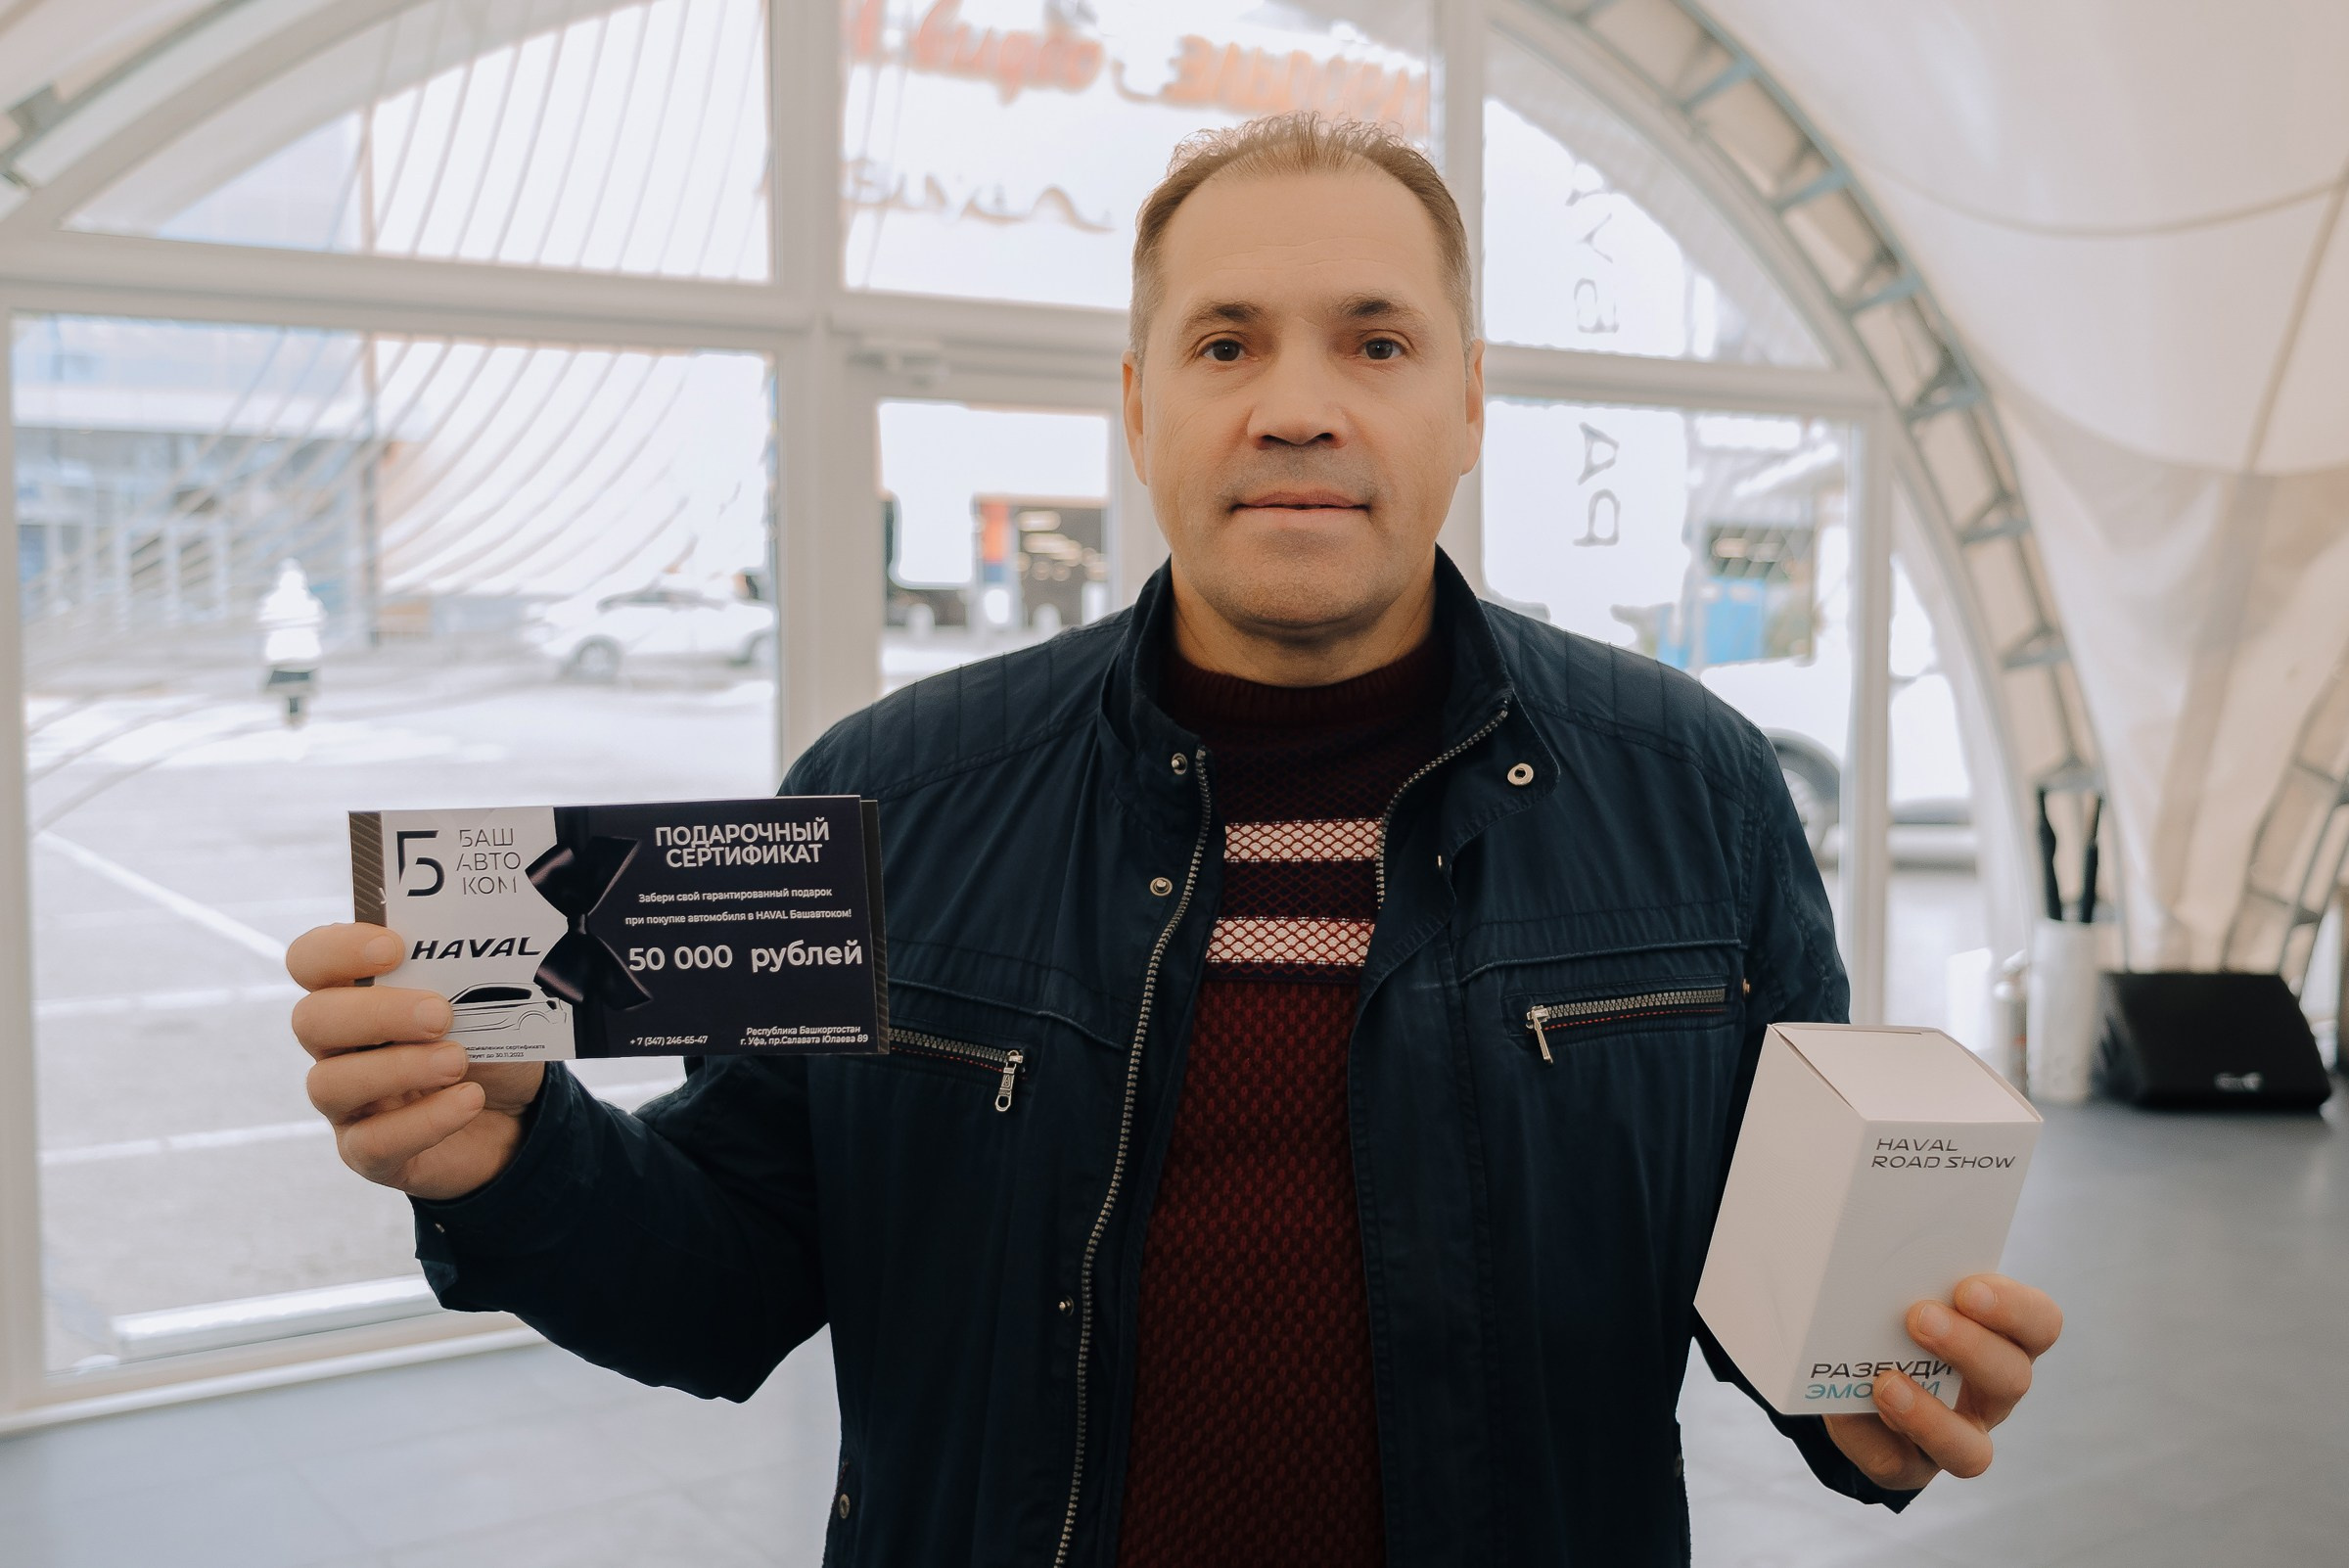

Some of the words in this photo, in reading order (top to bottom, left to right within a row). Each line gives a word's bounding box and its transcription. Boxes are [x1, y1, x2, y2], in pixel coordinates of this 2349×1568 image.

[459, 828, 514, 848] БАШ
[655, 816, 830, 848] ПОДАРОЧНЫЙ
[456, 852, 521, 871] АВТО
[666, 844, 823, 868] СЕРТИФИКАТ
[463, 876, 517, 895] КОМ
[638, 893, 674, 904] Забери
[676, 891, 700, 901] свой
[702, 888, 789, 902] гарантированный
[791, 889, 832, 899] подарок
[624, 917, 644, 927] при
[646, 915, 686, 926] покупке
[687, 911, 746, 922] автомобиля
[756, 910, 788, 920] HAVAL
[789, 908, 852, 919] Башавтоком!
[410, 936, 541, 960] HAVAL
[628, 947, 666, 971] 50
[673, 945, 733, 970] 000
[751, 940, 863, 973] рублей
[746, 1026, 798, 1037] Республика
[799, 1025, 861, 1036] Башкортостан
[748, 1037, 767, 1046] Уфа,
[821, 1034, 855, 1043] Юлаева
[856, 1034, 869, 1042] 89
[644, 1037, 666, 1046] (347)
[667, 1036, 709, 1045] 246-65-47
[1876, 1138, 1958, 1152] HAVAL
[1871, 1156, 1941, 1169] ROAD
[1944, 1156, 2015, 1169] SHOW
